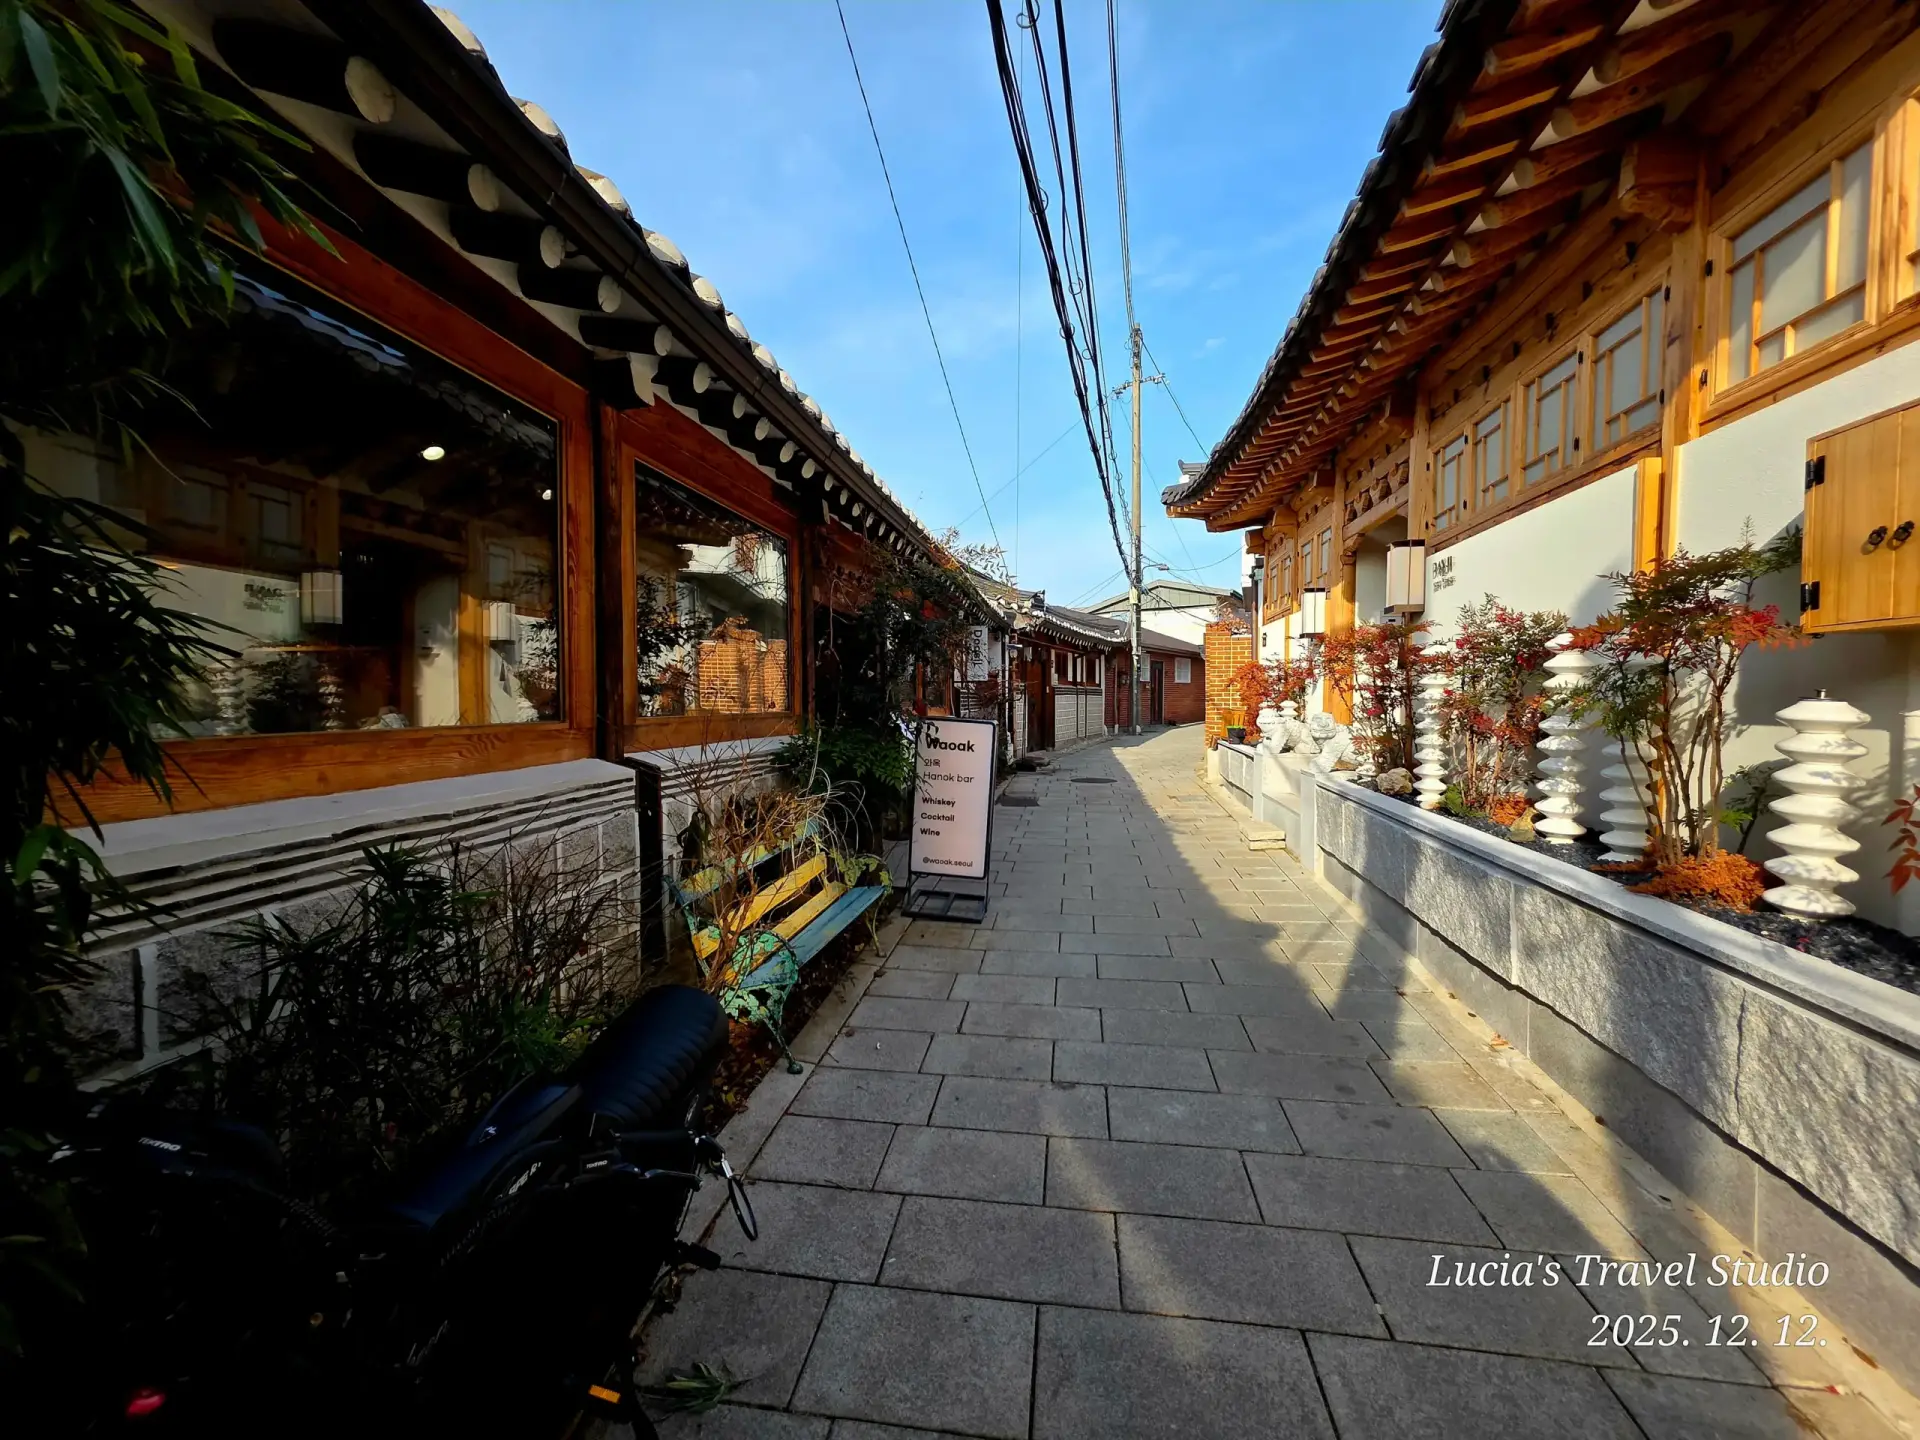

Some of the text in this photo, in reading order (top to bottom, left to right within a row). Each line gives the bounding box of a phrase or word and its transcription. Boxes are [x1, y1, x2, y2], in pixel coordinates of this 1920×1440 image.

[926, 737, 975, 752] Waoak
[923, 771, 975, 783] Hanok bar
[922, 796, 956, 808] Whiskey
[920, 812, 955, 822] Cocktail
[920, 828, 941, 836] Wine
[922, 856, 974, 868] @waoak.seoul
